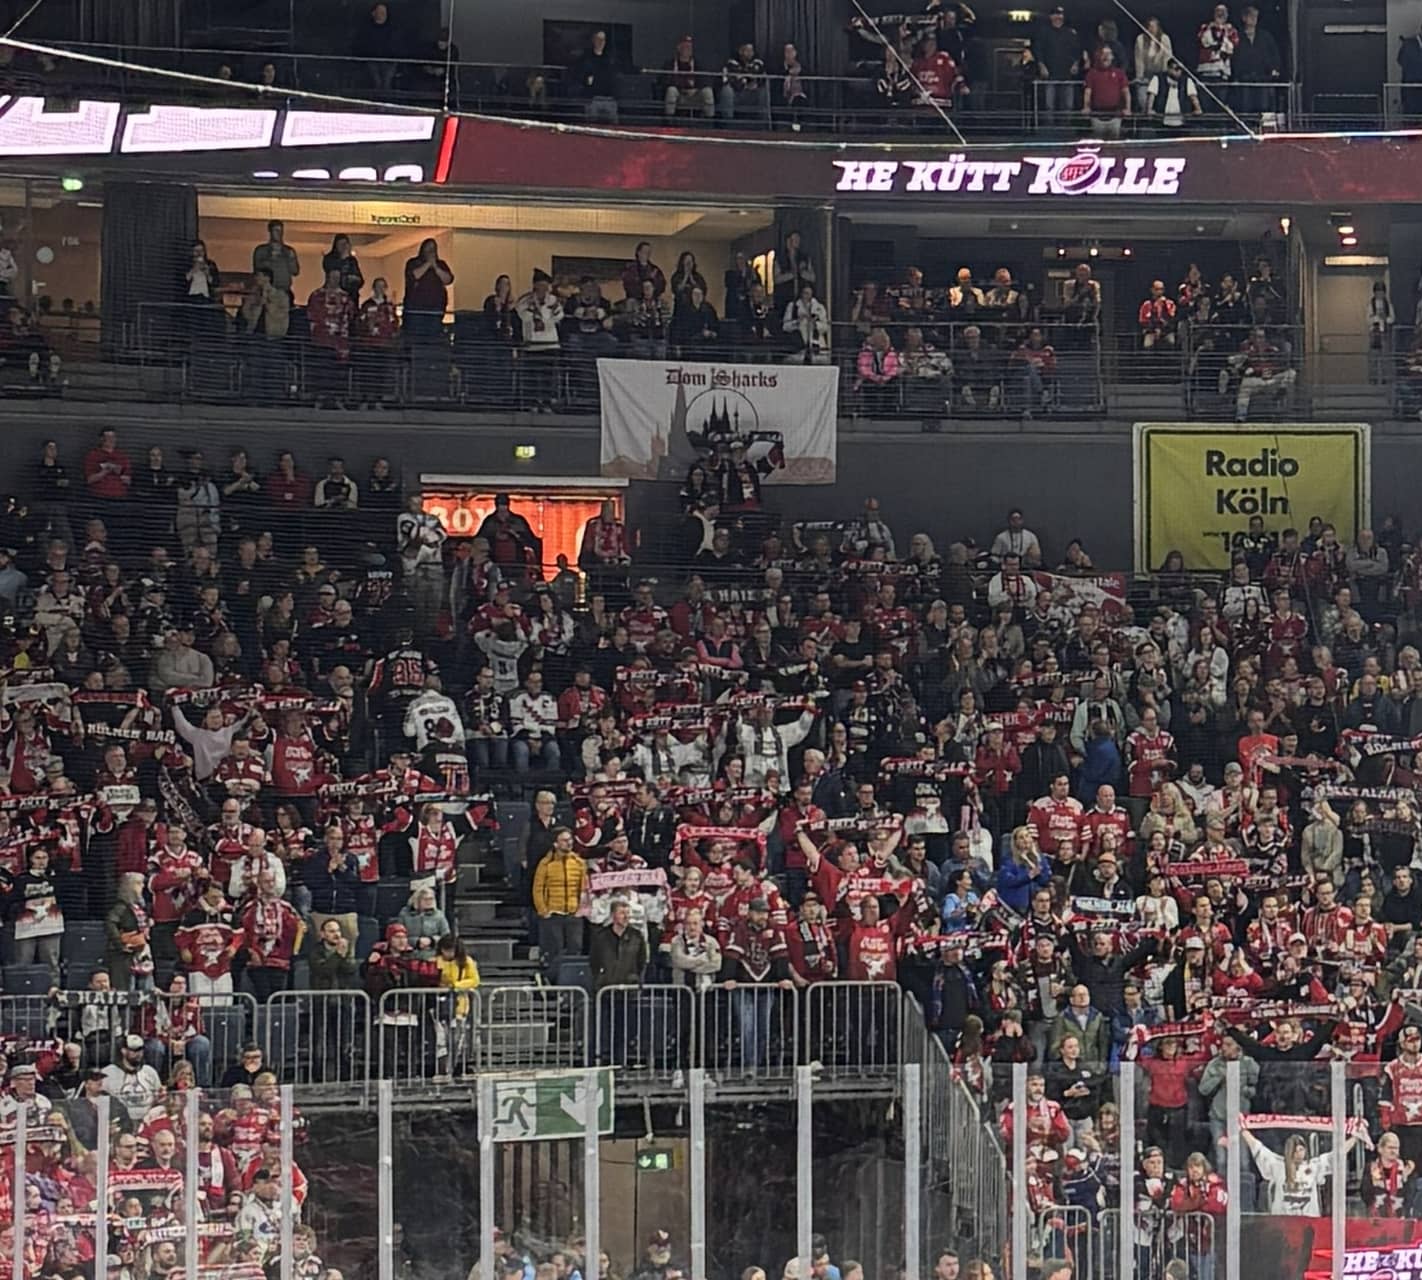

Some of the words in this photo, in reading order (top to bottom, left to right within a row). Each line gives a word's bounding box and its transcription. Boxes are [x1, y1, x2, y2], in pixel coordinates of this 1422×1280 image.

[832, 160, 899, 192] HE
[902, 153, 1022, 192] KÜTT
[665, 367, 706, 386] Dom
[711, 367, 778, 388] Sharks
[1205, 449, 1300, 477] Radio
[1216, 487, 1289, 516] Köln
[1342, 1251, 1380, 1273] HE
